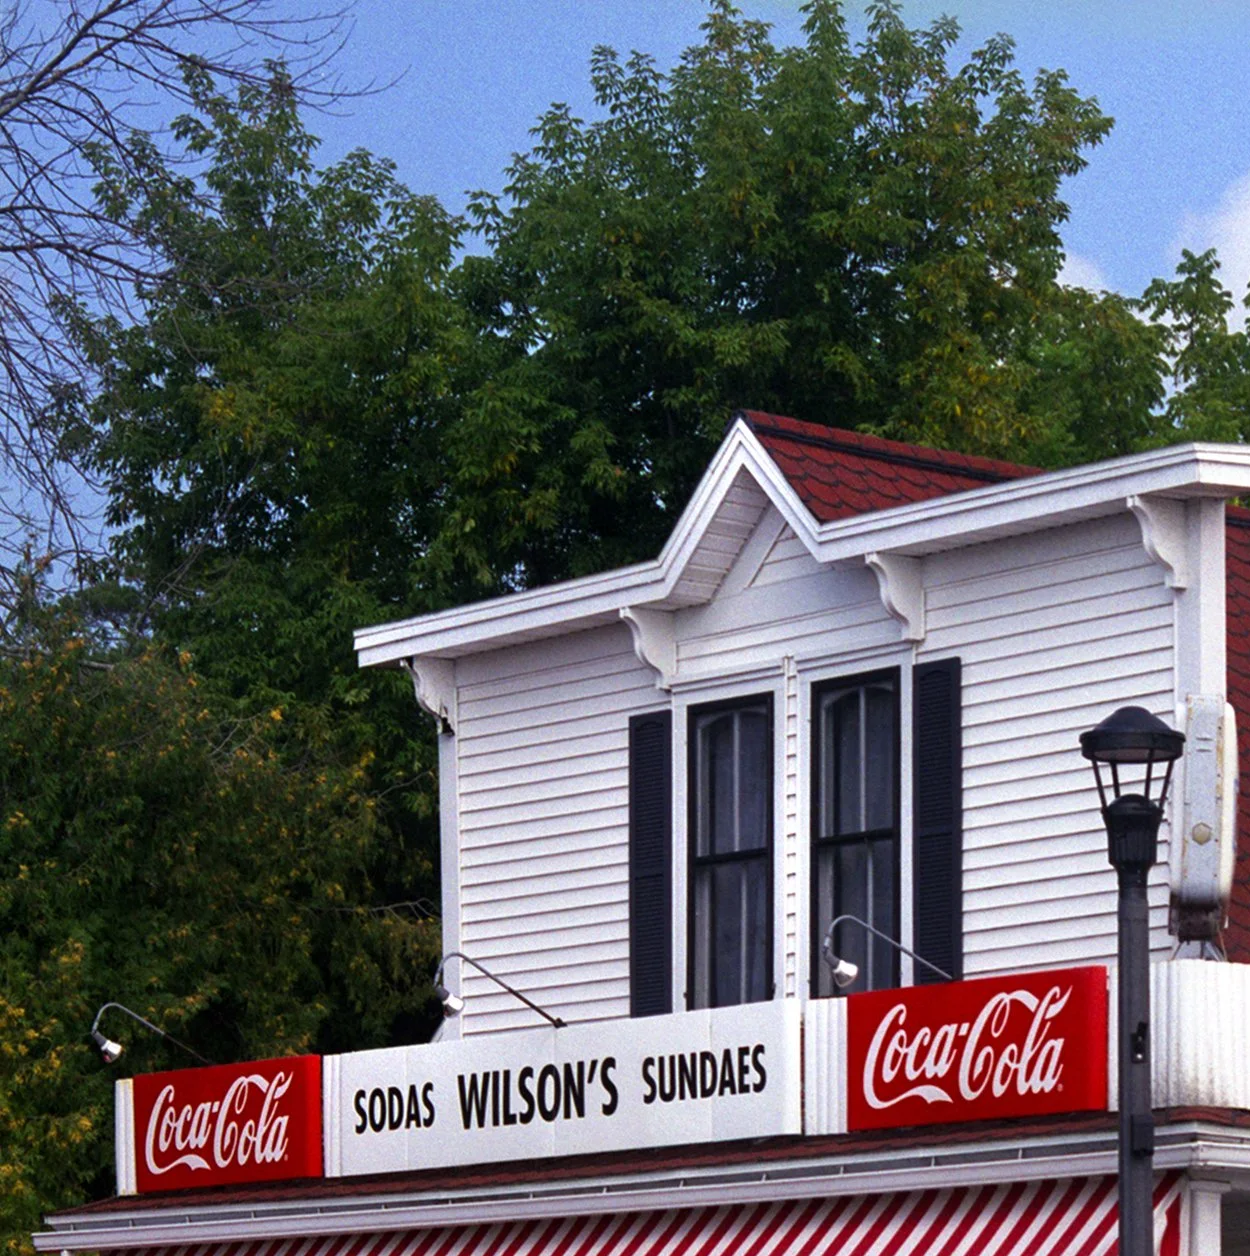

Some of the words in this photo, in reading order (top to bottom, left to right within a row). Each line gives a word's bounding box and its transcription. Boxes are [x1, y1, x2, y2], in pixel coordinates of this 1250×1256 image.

[354, 1082, 435, 1135] SODAS
[457, 1056, 619, 1130] WILSON'S
[642, 1044, 767, 1105] SUNDAES
[864, 985, 1073, 1109] Coca-Cola
[145, 1071, 293, 1175] Coca-Cola
